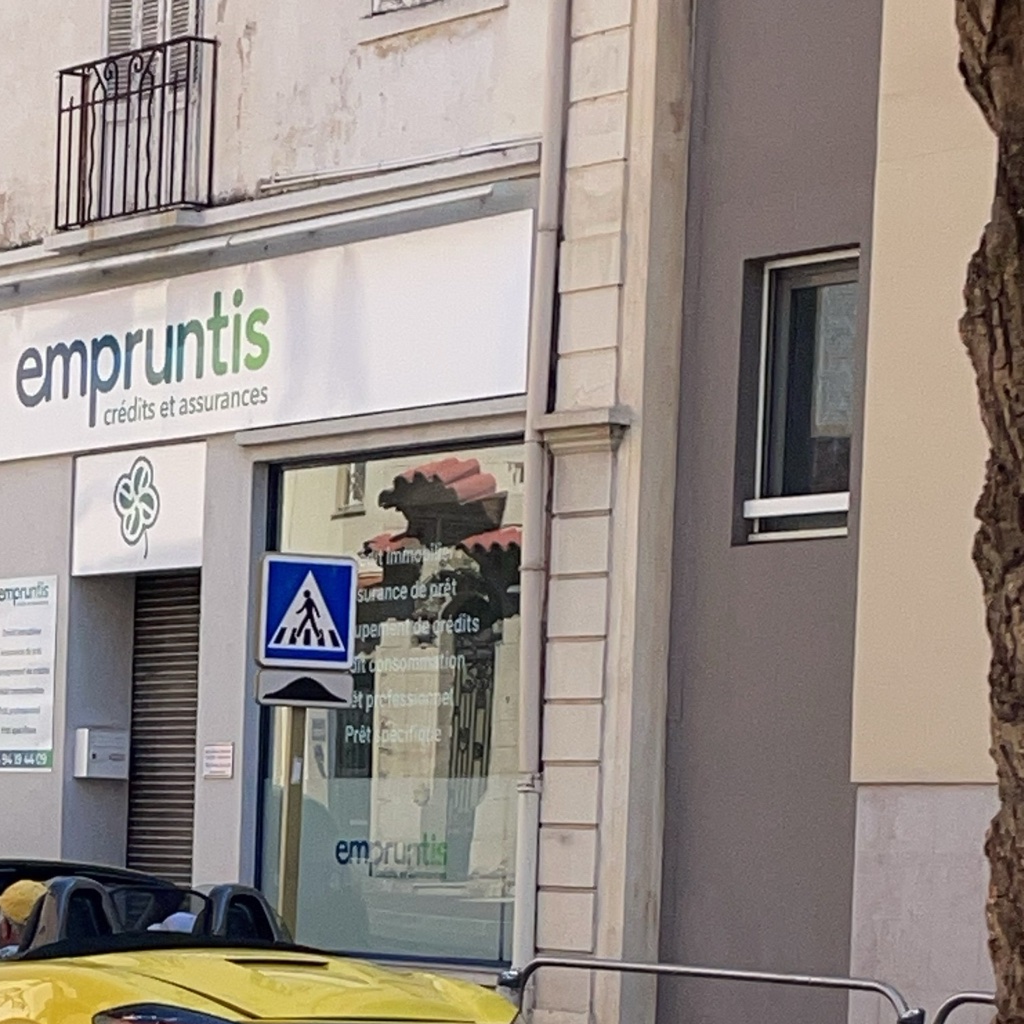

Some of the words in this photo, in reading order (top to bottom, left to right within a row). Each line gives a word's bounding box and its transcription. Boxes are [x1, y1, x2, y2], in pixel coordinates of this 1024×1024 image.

[16, 288, 271, 428] empruntis
[103, 395, 156, 426] crédits
[159, 395, 177, 419] et
[178, 385, 269, 417] assurances
[410, 579, 427, 600] de
[429, 577, 458, 602] prêt
[412, 616, 431, 635] de
[432, 613, 480, 635] crédits
[344, 724, 372, 744] Prêt
[335, 832, 448, 877] empruntis
